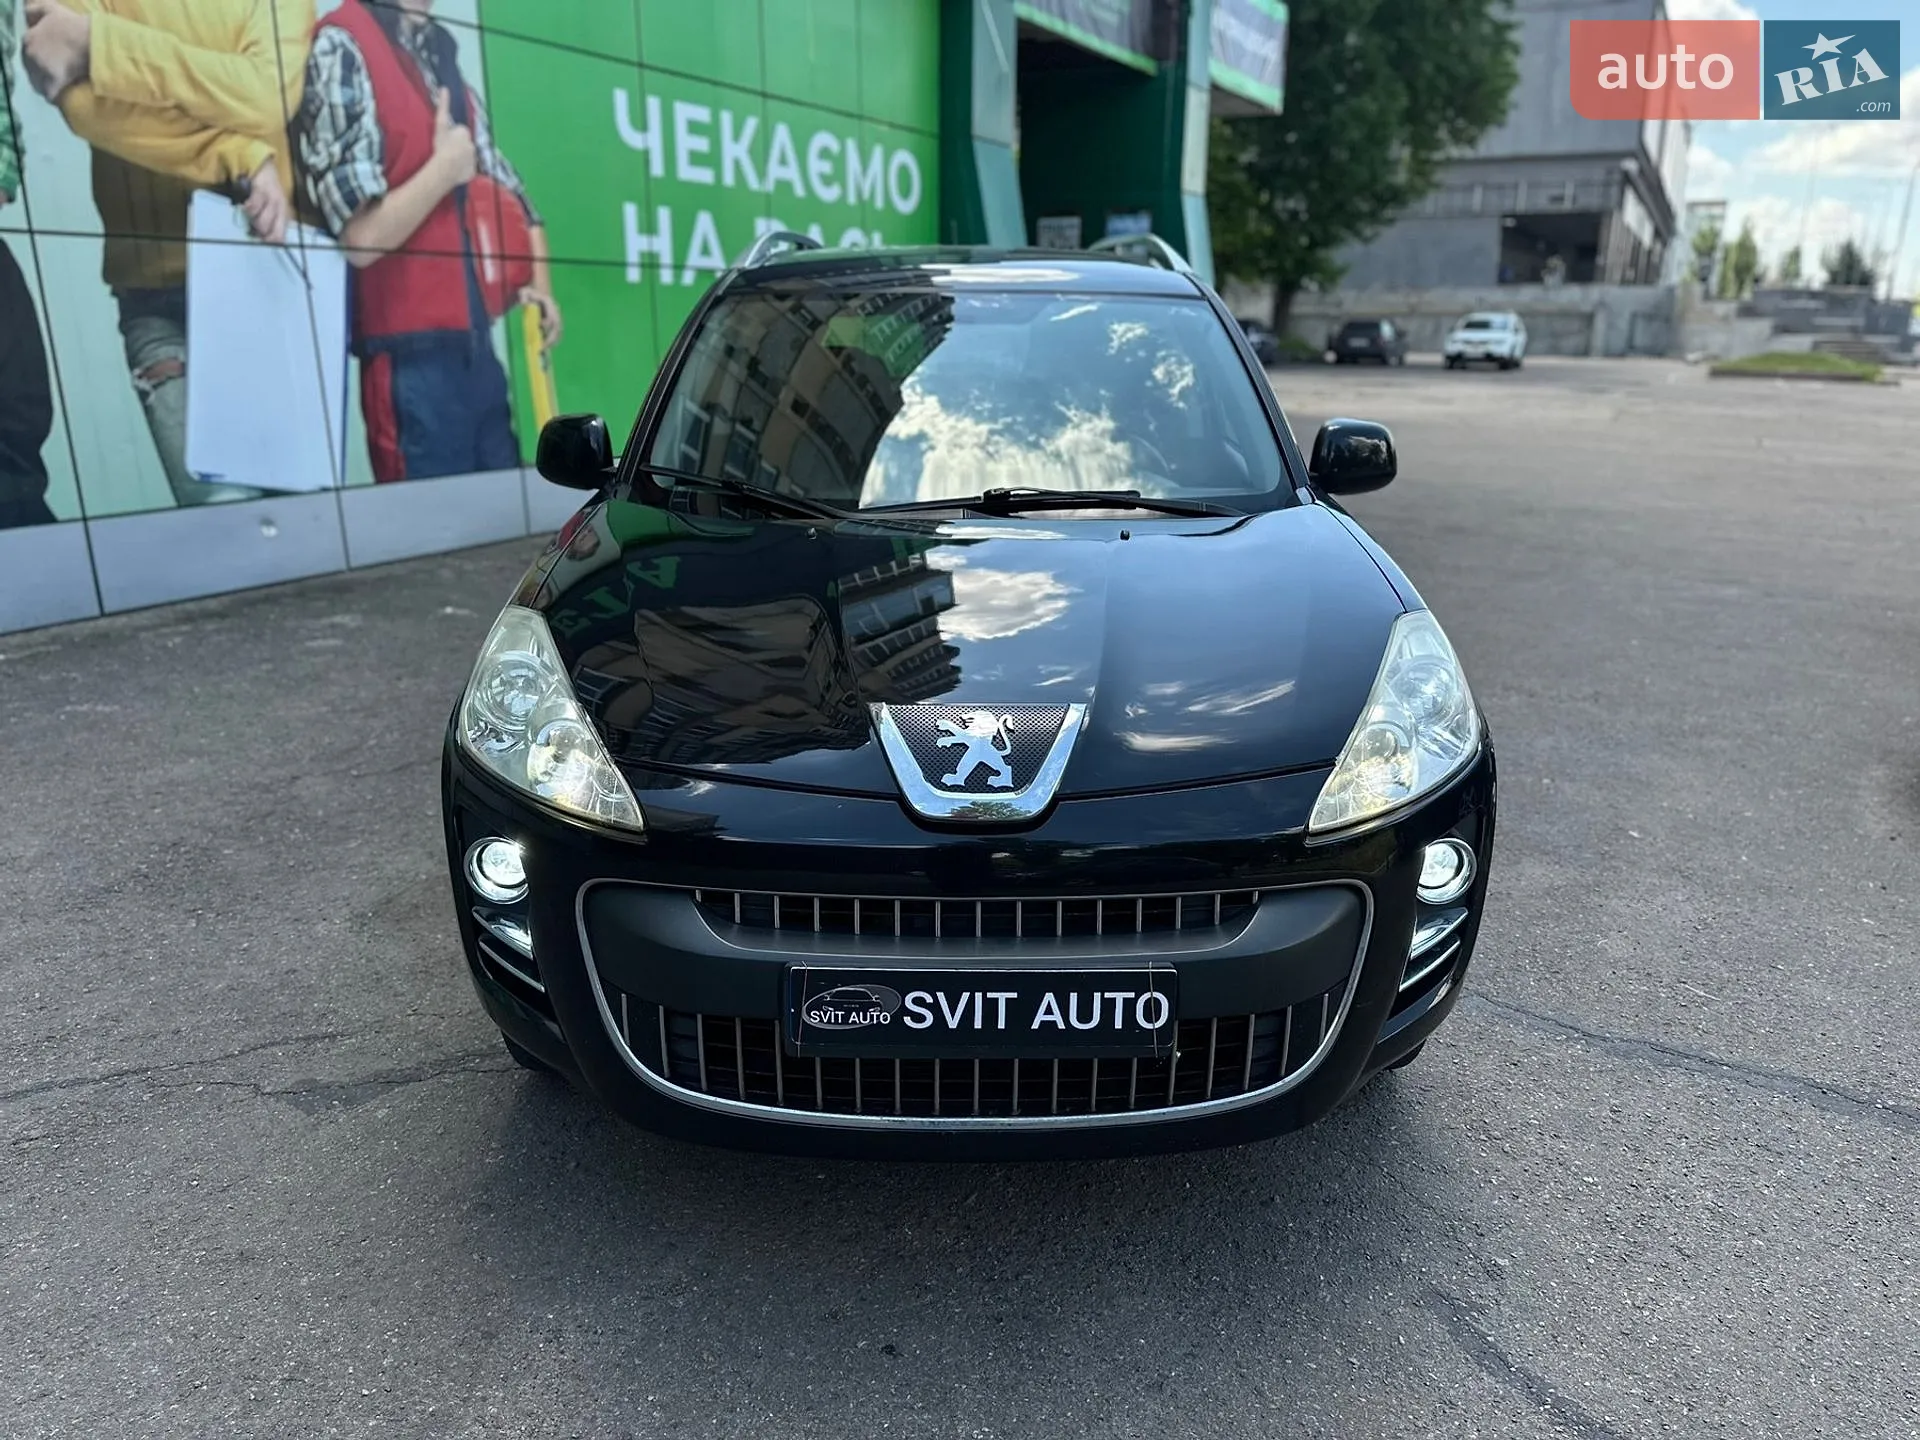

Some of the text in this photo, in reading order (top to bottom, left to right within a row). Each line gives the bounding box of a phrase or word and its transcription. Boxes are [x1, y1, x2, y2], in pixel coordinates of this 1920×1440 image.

[613, 87, 922, 215] ЧЕКАЄМО
[622, 201, 728, 286] НА
[810, 1010, 891, 1025] SVIT AUTO
[903, 990, 1170, 1031] SVIT AUTO
